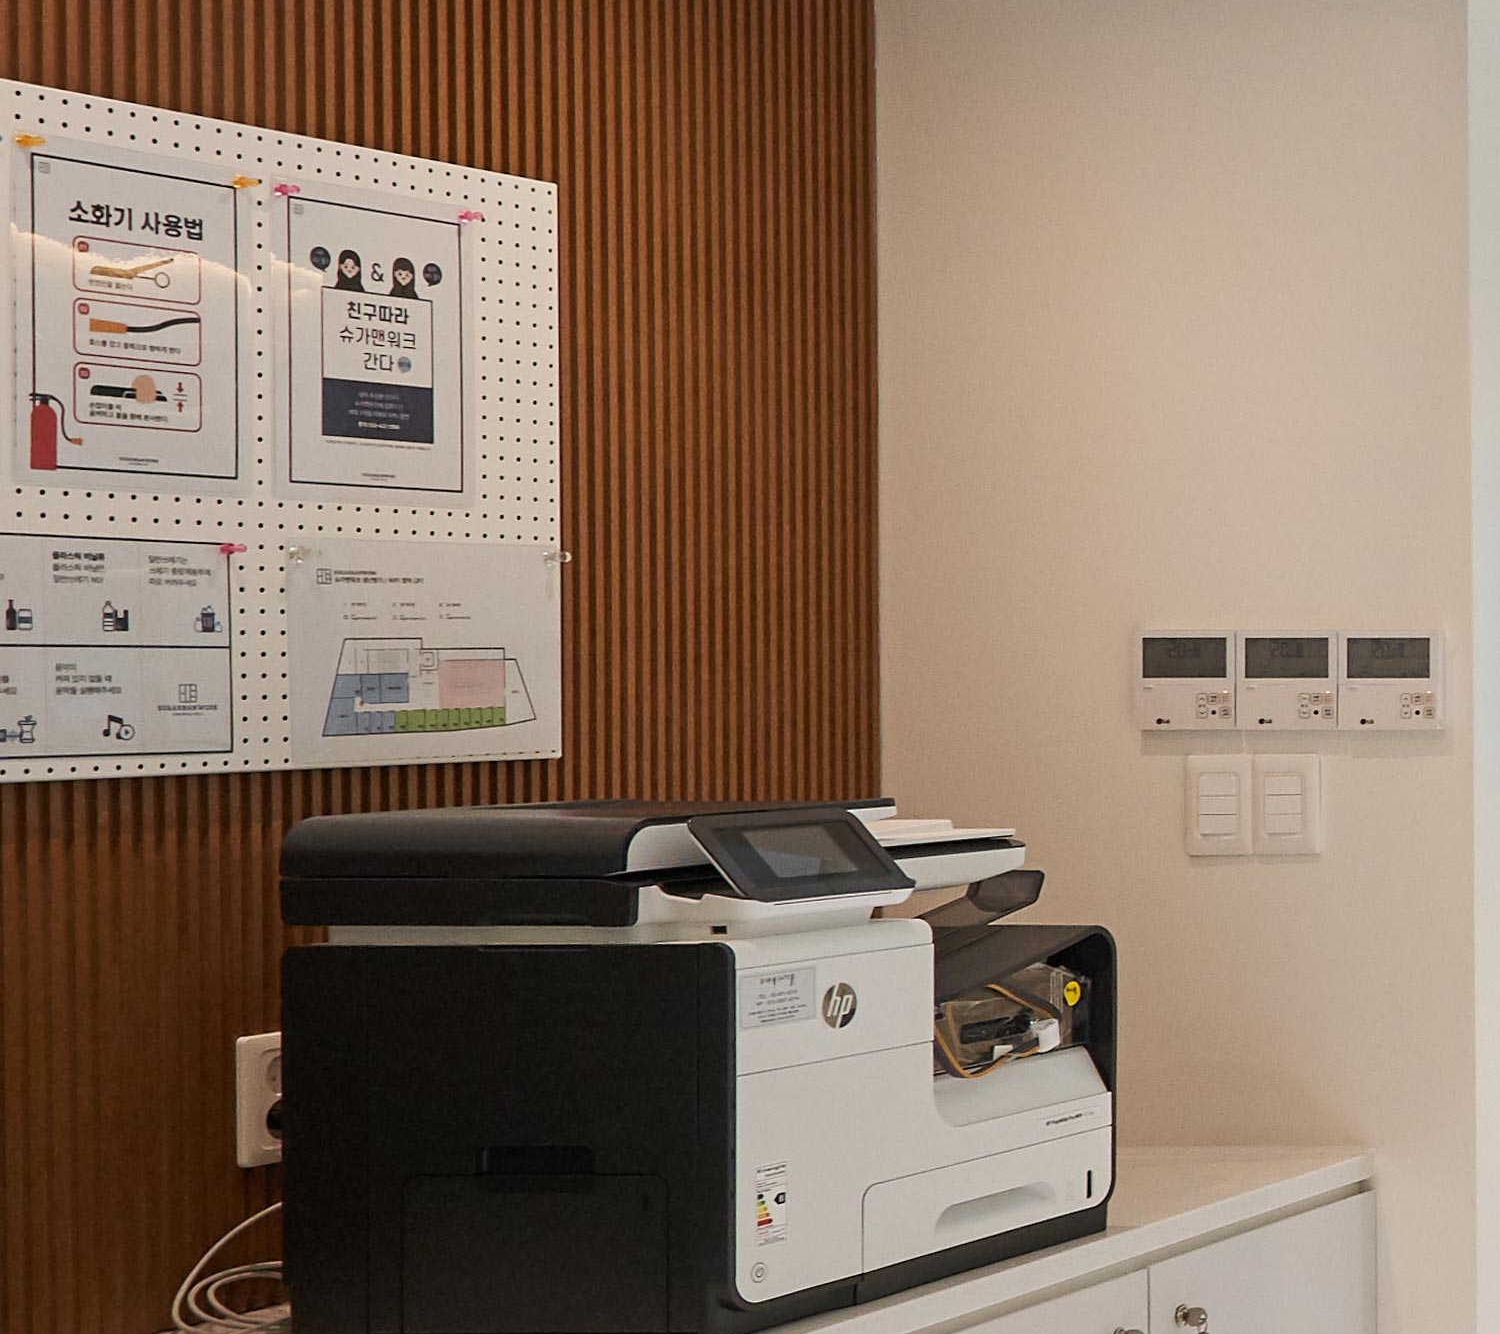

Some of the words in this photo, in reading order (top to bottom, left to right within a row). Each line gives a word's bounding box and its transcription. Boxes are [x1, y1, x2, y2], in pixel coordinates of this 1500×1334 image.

[68, 200, 133, 231] 소화기
[141, 212, 203, 241] 사용법
[347, 301, 410, 325] 친구따라
[339, 326, 417, 350] 슈가맨워크
[363, 352, 394, 372] 간다
[826, 982, 854, 1029] hp
